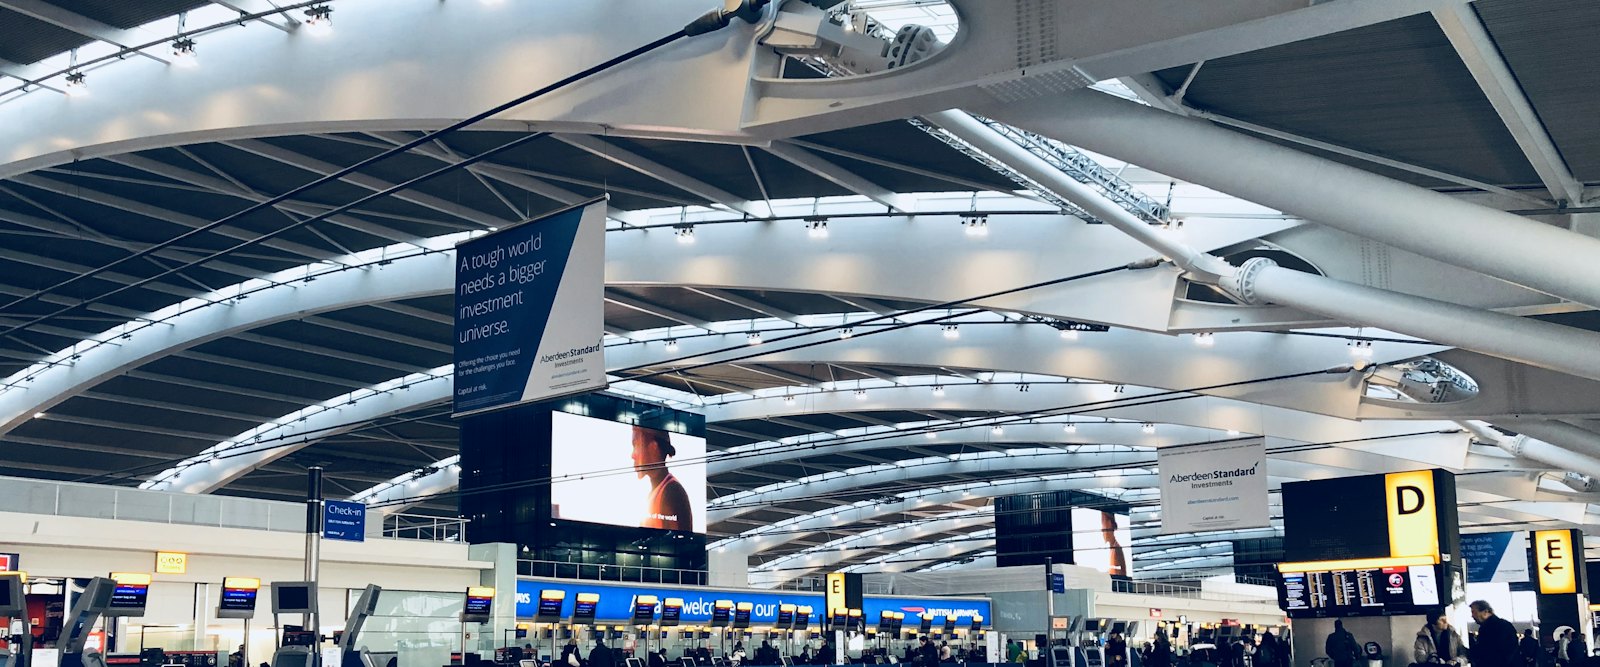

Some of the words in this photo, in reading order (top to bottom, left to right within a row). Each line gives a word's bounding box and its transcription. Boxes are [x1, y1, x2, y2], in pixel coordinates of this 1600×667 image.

[460, 256, 469, 273] A
[472, 245, 505, 269] tough
[508, 231, 542, 258] world
[460, 272, 495, 296] needs
[498, 272, 505, 285] a
[509, 260, 547, 285] bigger
[460, 290, 523, 320] investment
[459, 320, 510, 344] universe.
[458, 359, 476, 368] Offering
[485, 354, 499, 362] choice
[499, 352, 508, 360] you
[508, 348, 521, 356] need
[473, 364, 496, 373] challenges
[496, 362, 505, 371] you
[555, 357, 584, 368] Investments
[458, 386, 473, 395] Capital
[1191, 480, 1233, 489] Investments
[328, 504, 362, 516] Check-in
[1396, 485, 1425, 515] D
[1546, 539, 1562, 559] E
[832, 579, 840, 594] E
[682, 596, 736, 615] welcoe
[754, 602, 776, 617] our
